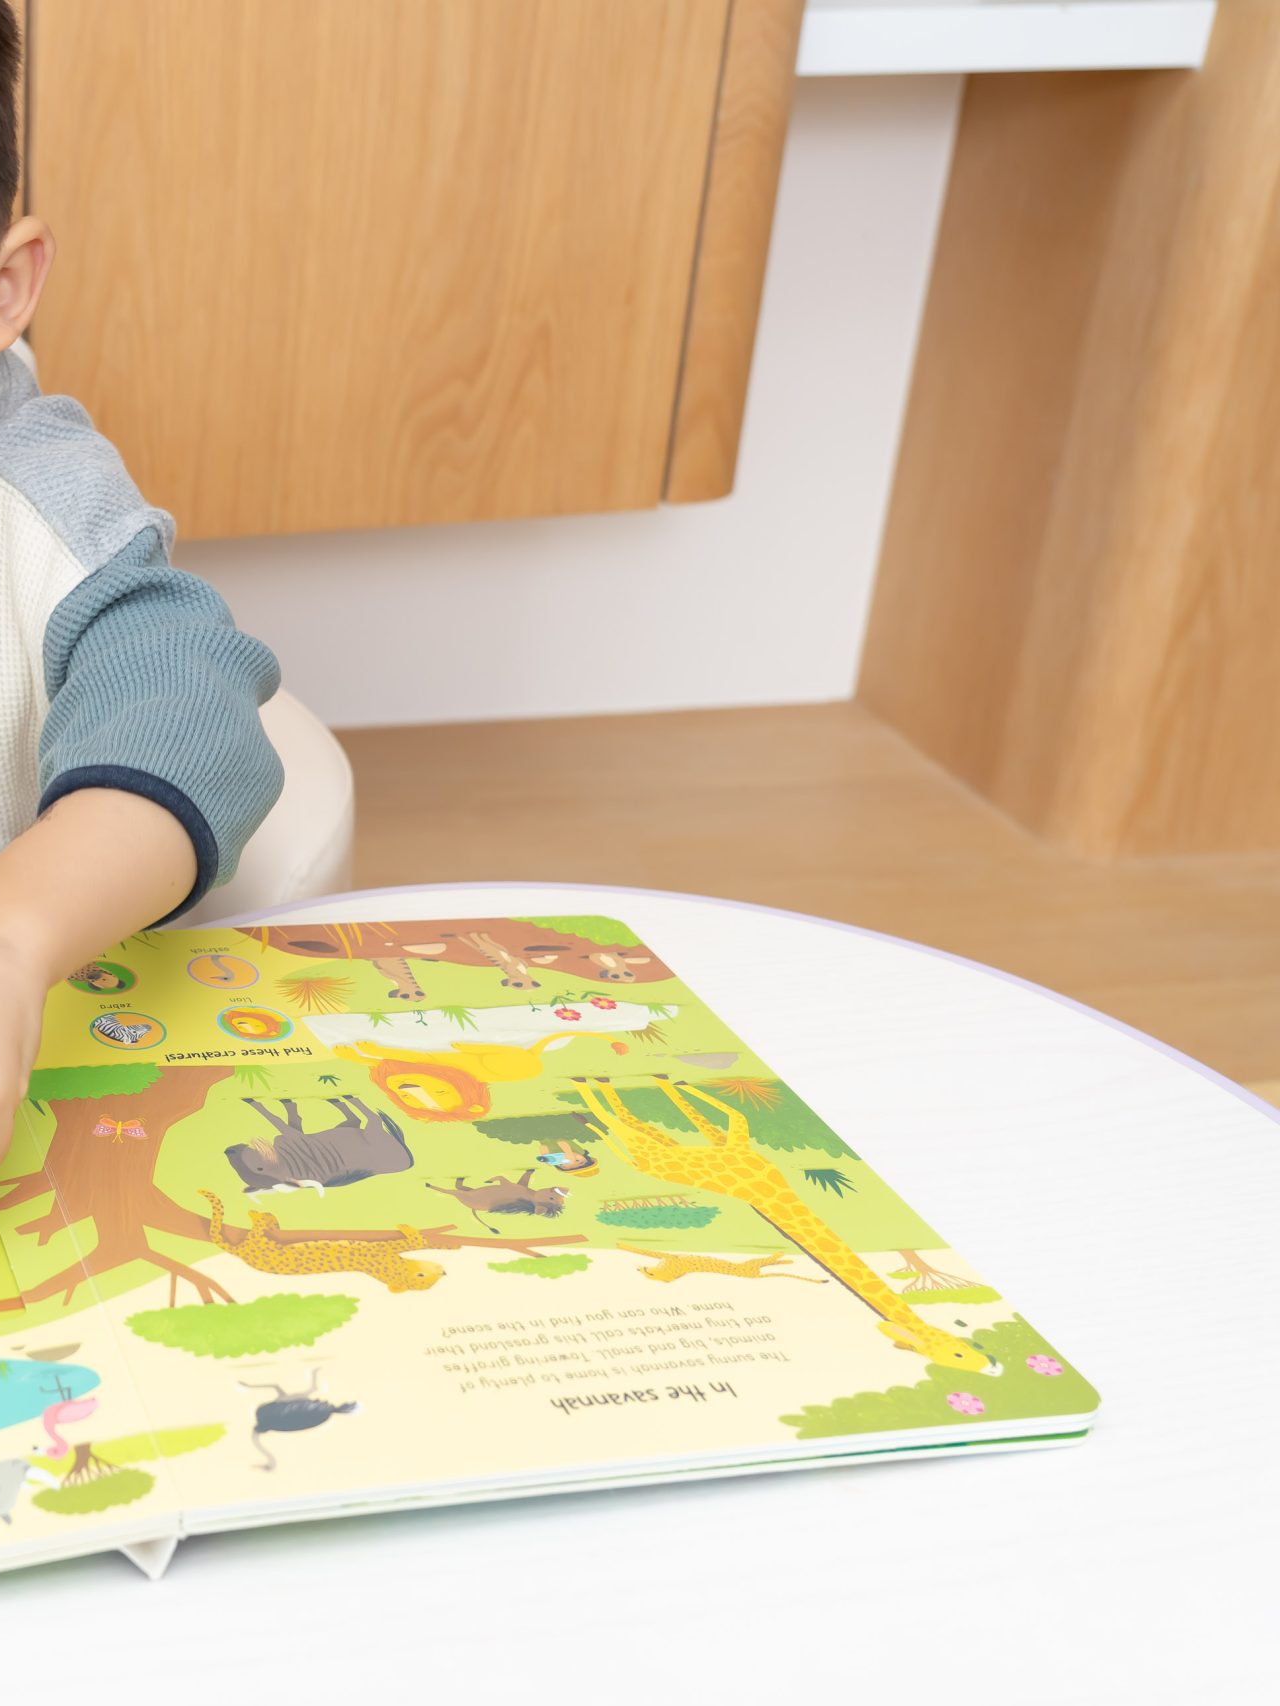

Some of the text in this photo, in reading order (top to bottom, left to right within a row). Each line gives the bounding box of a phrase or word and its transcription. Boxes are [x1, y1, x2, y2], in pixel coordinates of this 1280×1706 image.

[190, 947, 231, 956] ostrich
[99, 1002, 133, 1011] zebra
[165, 1046, 313, 1063] Find these creatures!
[424, 1316, 772, 1356] and tiny meerkats call this grassland their
[441, 1301, 734, 1339] home. Who can you find in the scene?
[442, 1332, 776, 1373] animals, big and small. Towering giraffes
[459, 1351, 790, 1393] The sunny savannah is home to plenty of
[550, 1382, 737, 1415] In the savannah
